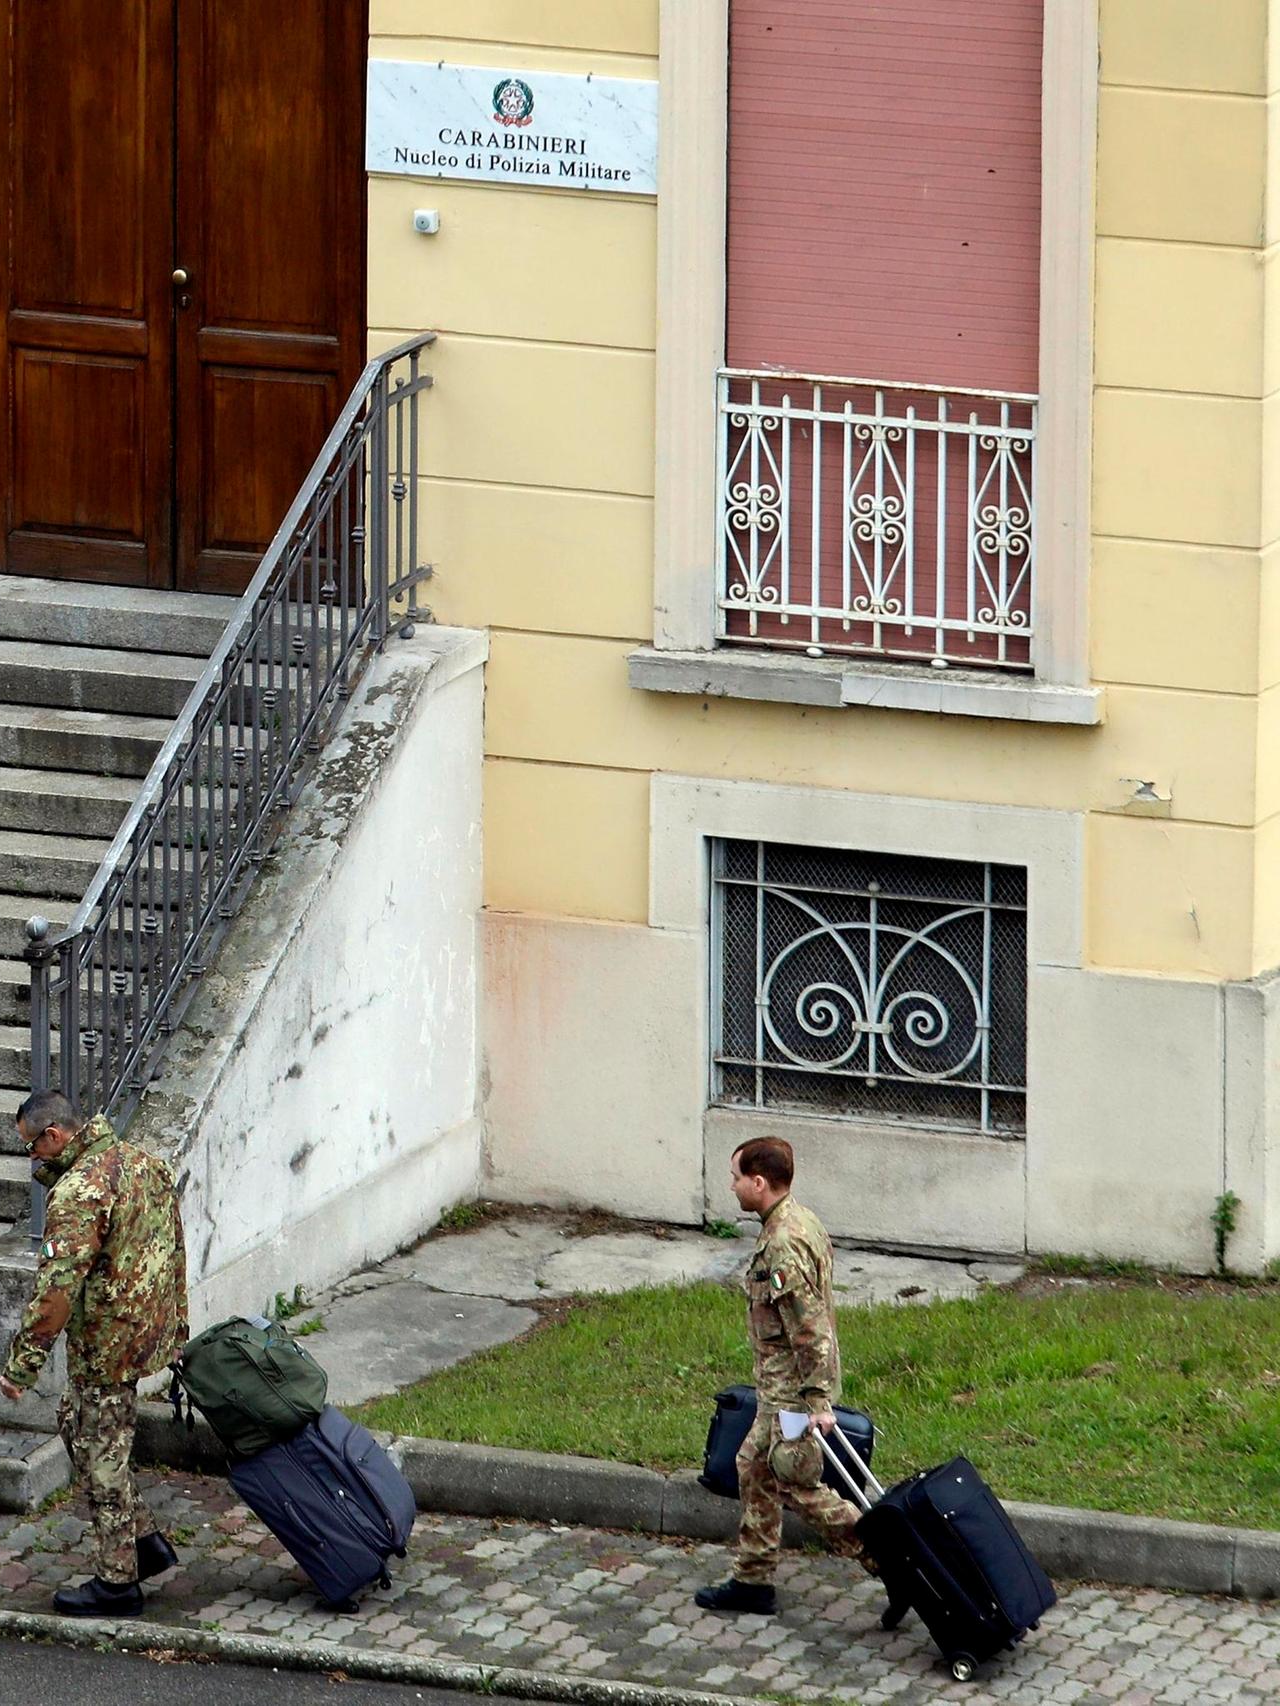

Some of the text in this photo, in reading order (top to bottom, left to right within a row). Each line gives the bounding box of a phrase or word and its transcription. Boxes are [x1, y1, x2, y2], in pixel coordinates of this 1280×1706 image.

[438, 128, 587, 155] CARABINIERI
[394, 147, 631, 181] Nucleo di Polizia Militare
